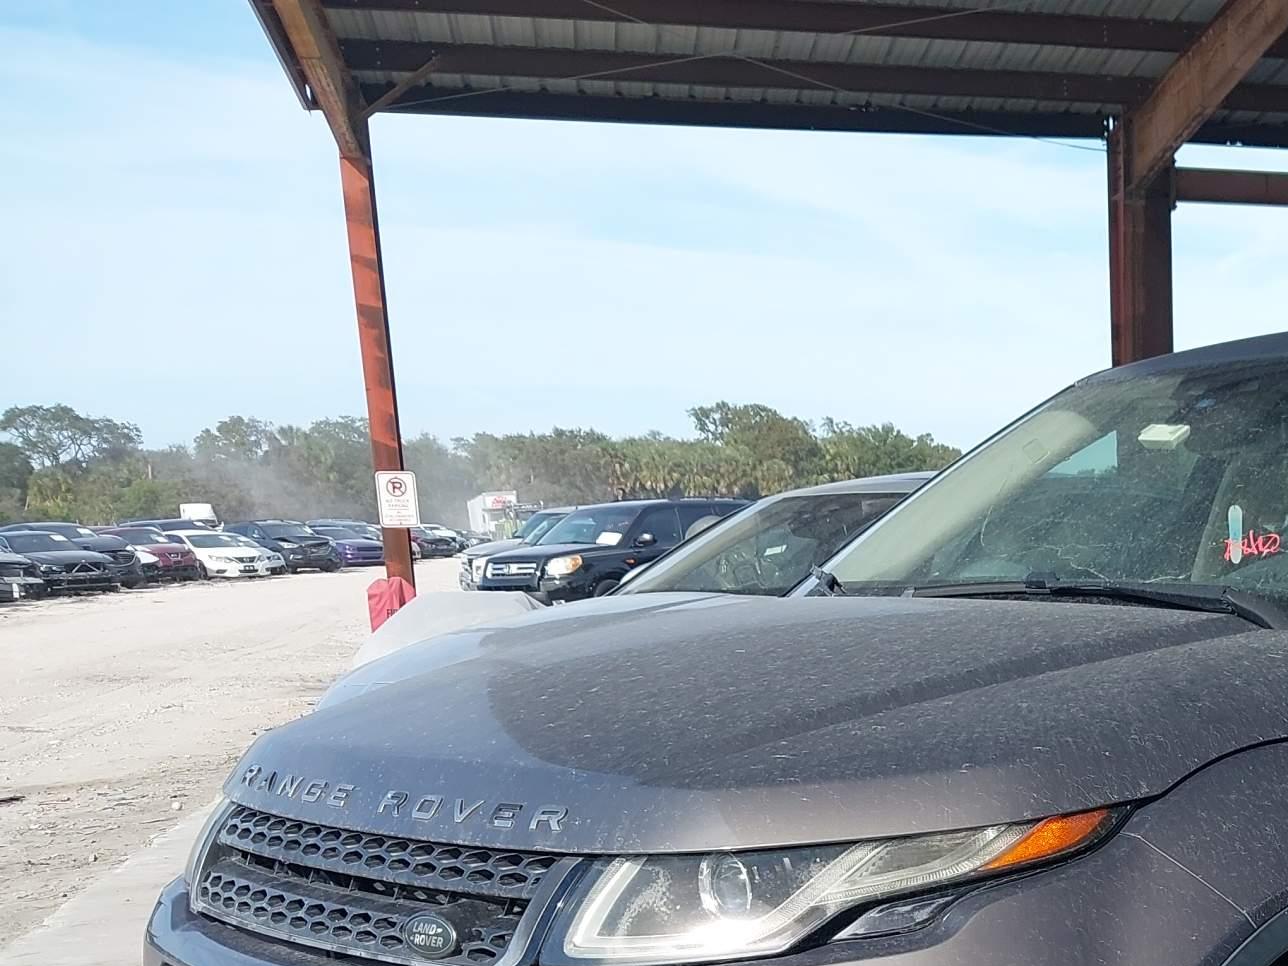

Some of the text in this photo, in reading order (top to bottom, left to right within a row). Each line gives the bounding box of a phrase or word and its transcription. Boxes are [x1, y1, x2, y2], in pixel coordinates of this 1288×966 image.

[240, 764, 569, 833] RANGE ROVER
[412, 920, 438, 935] LAND
[413, 933, 444, 949] ROVER
